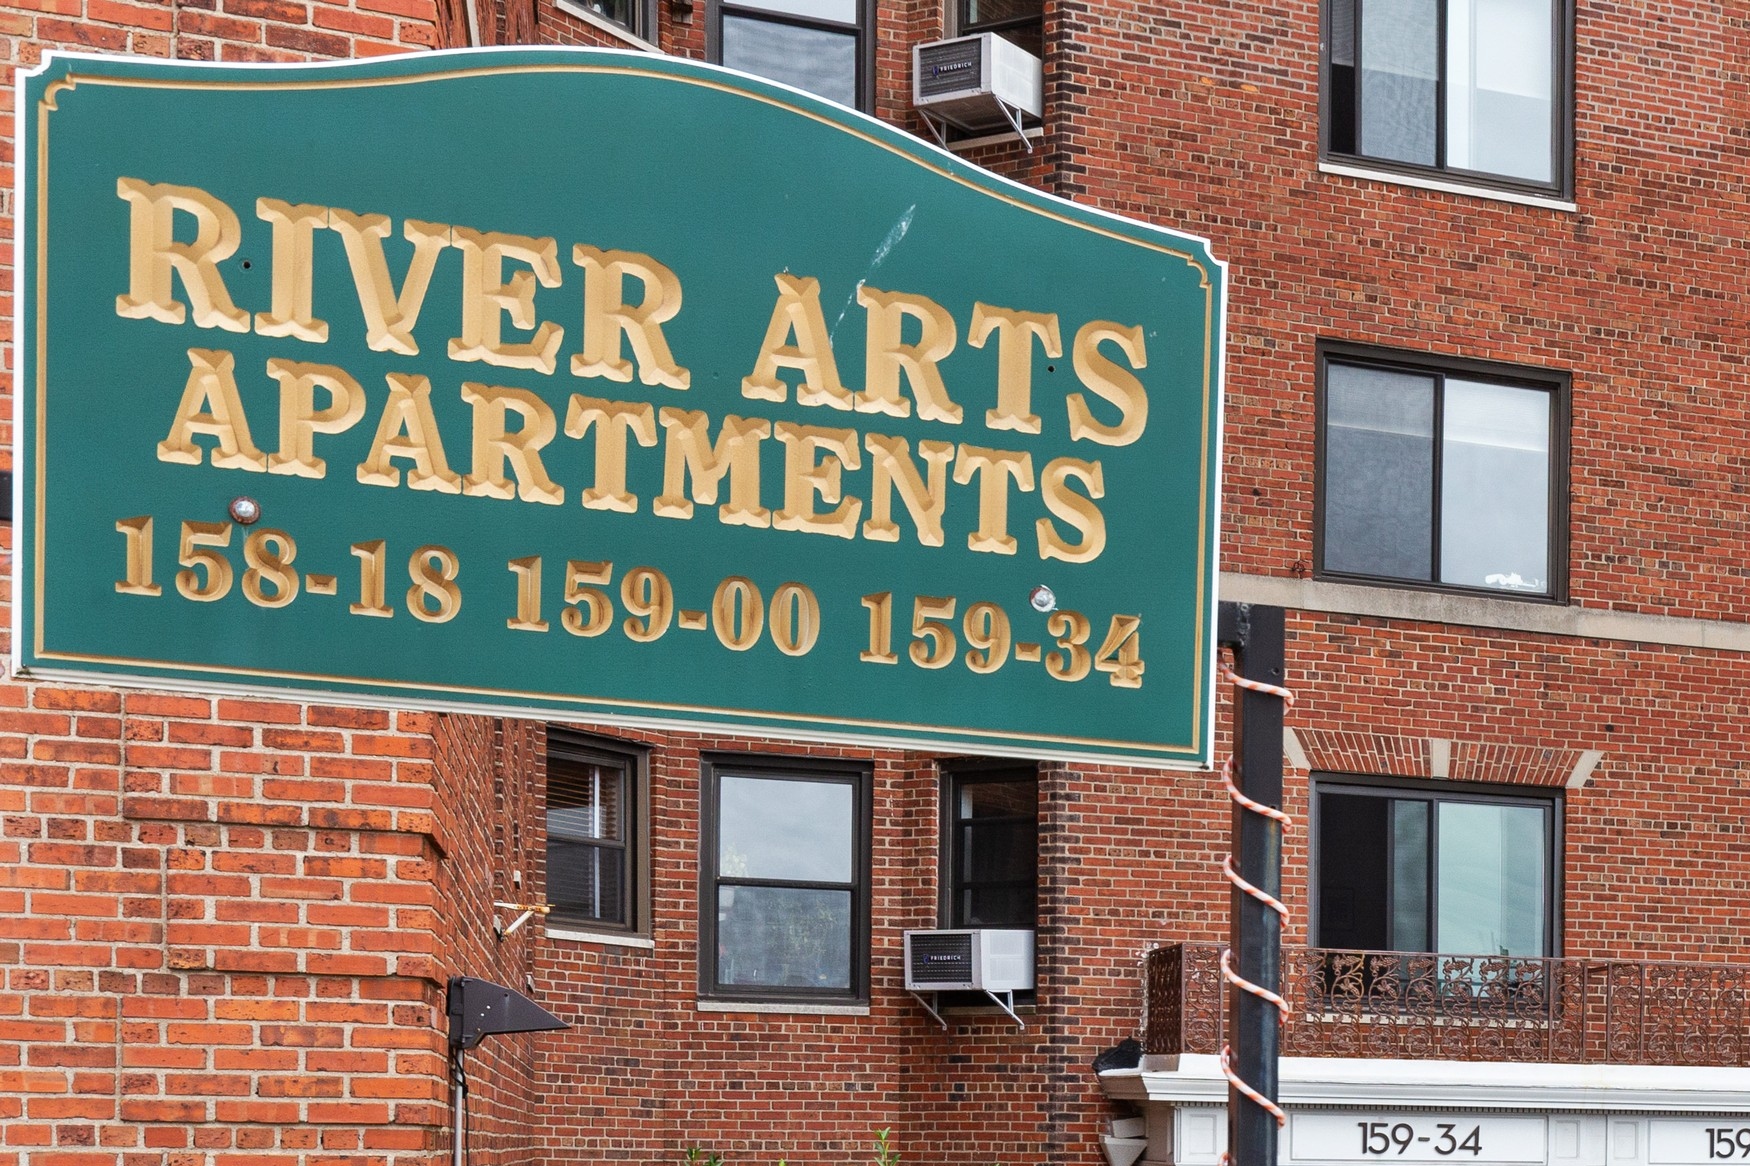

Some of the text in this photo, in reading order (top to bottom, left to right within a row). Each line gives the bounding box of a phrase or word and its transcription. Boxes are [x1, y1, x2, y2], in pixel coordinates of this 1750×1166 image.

[940, 61, 972, 72] FRIEDRICH
[116, 177, 1149, 446] RIVER ARTS
[157, 348, 1106, 562] APARTMENTS
[115, 516, 1145, 688] 158-18 159-00 159-34
[1357, 1122, 1483, 1156] 159-34
